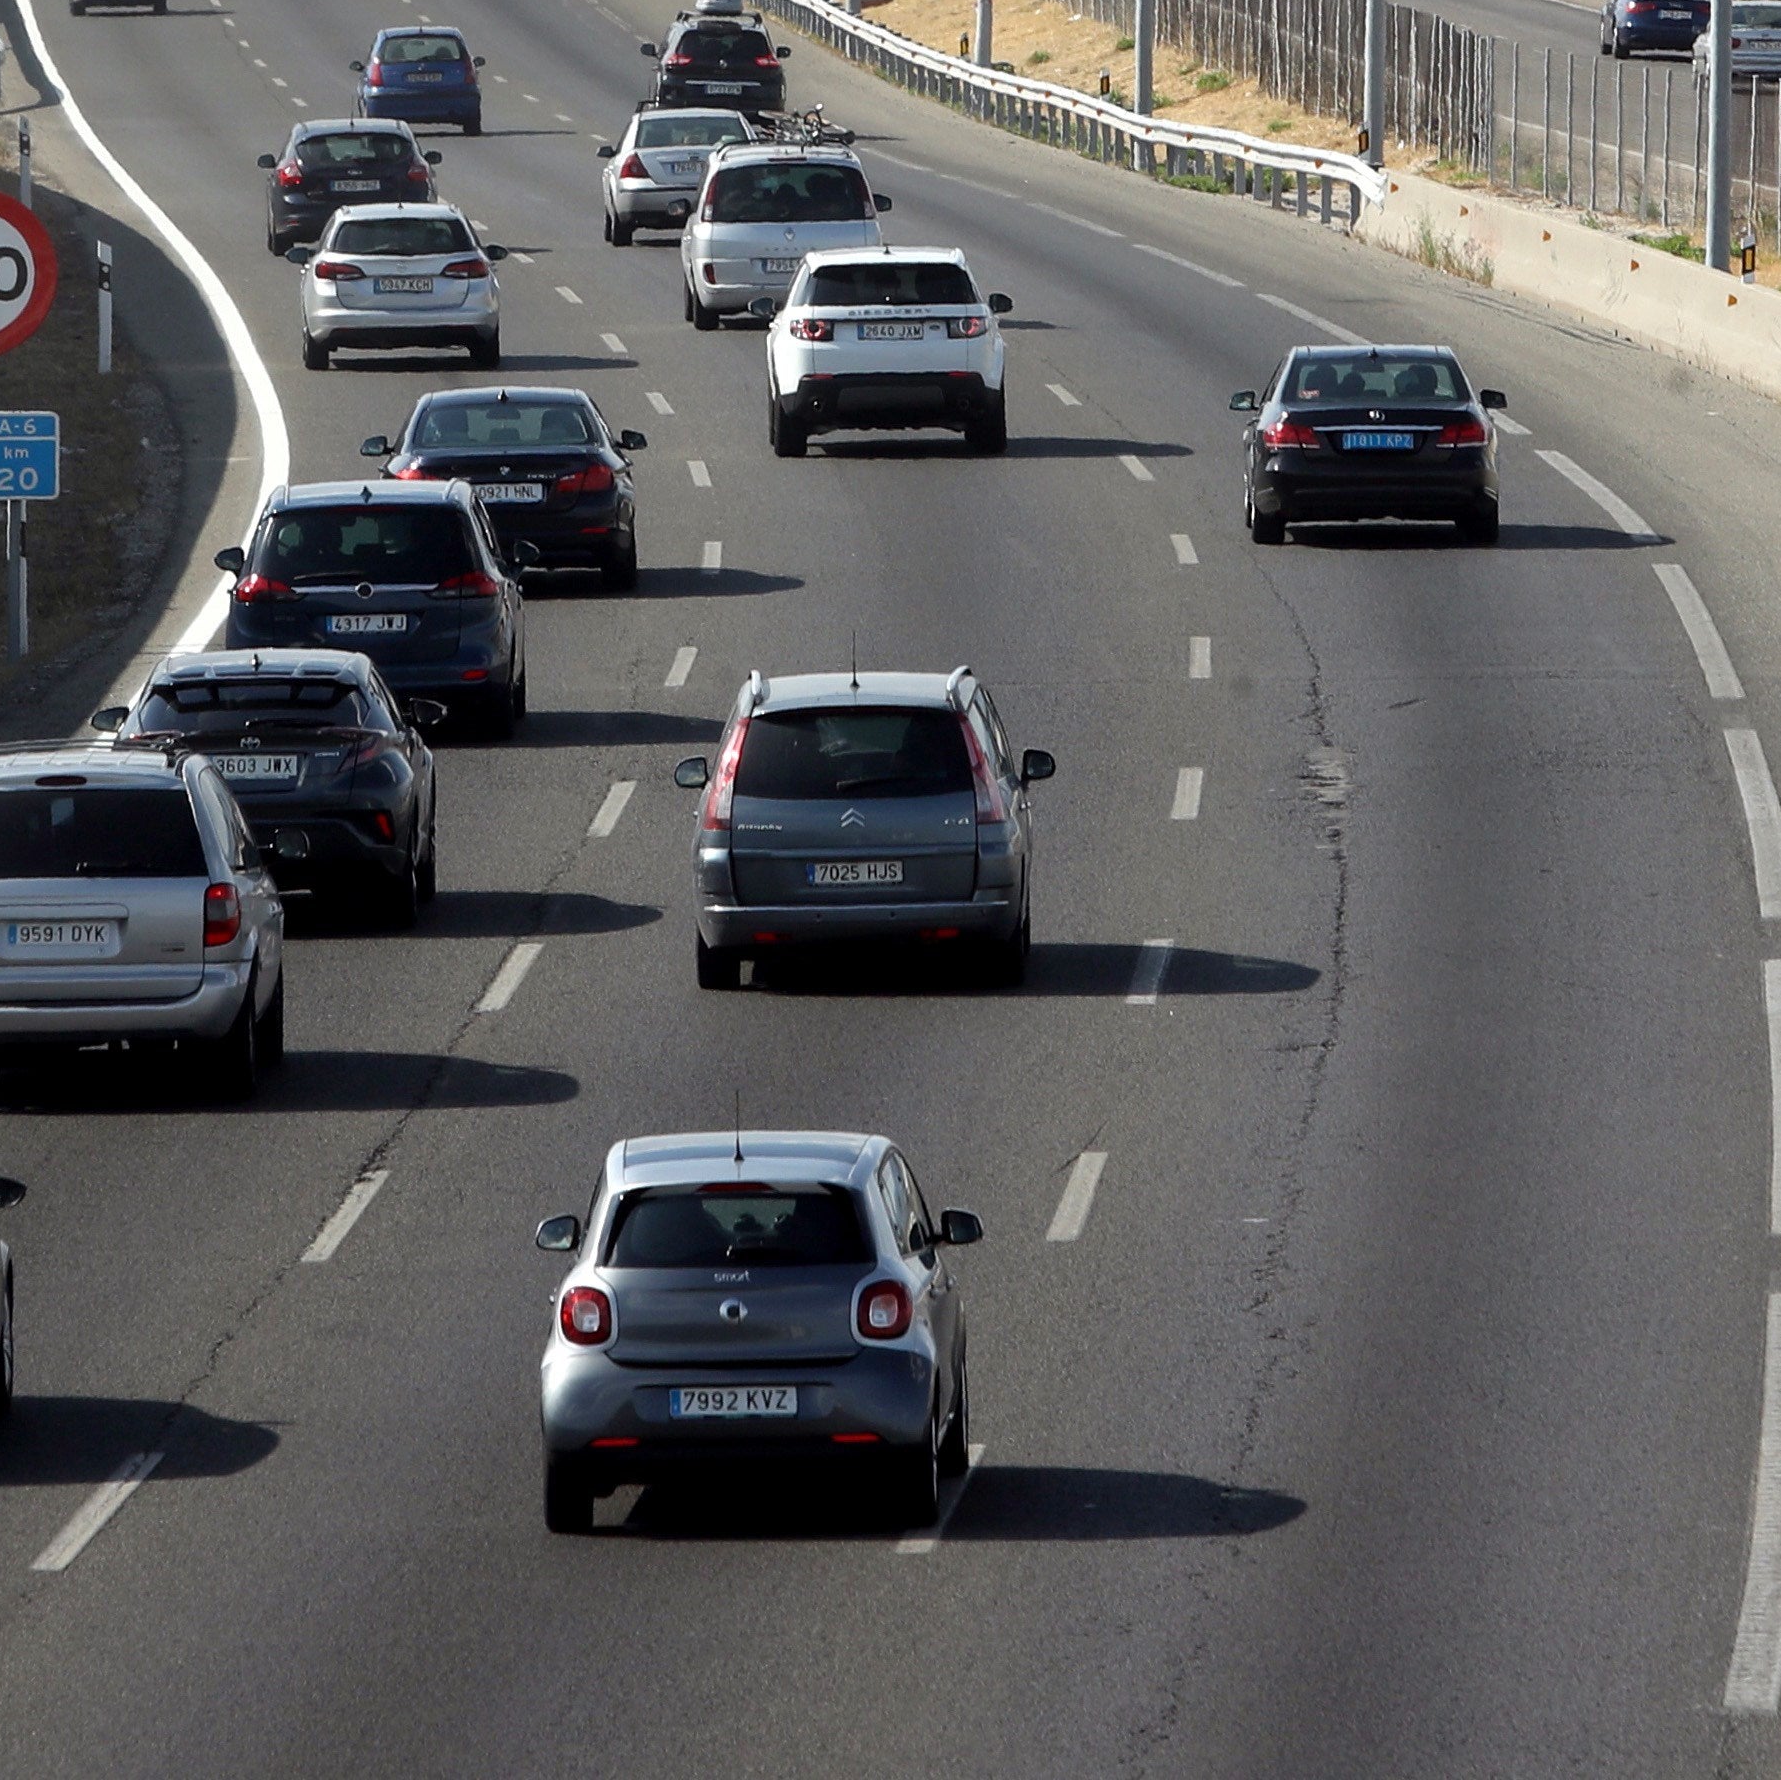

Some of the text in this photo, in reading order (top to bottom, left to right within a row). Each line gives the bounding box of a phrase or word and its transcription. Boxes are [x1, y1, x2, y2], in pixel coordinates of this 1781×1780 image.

[5, 445, 29, 459] km
[332, 616, 371, 633] 4317
[216, 754, 297, 775] 3603 JWX
[819, 863, 898, 882] 7025 HJS
[19, 924, 106, 945] 9591 DYK
[683, 1388, 789, 1413] 7992 KVZ
